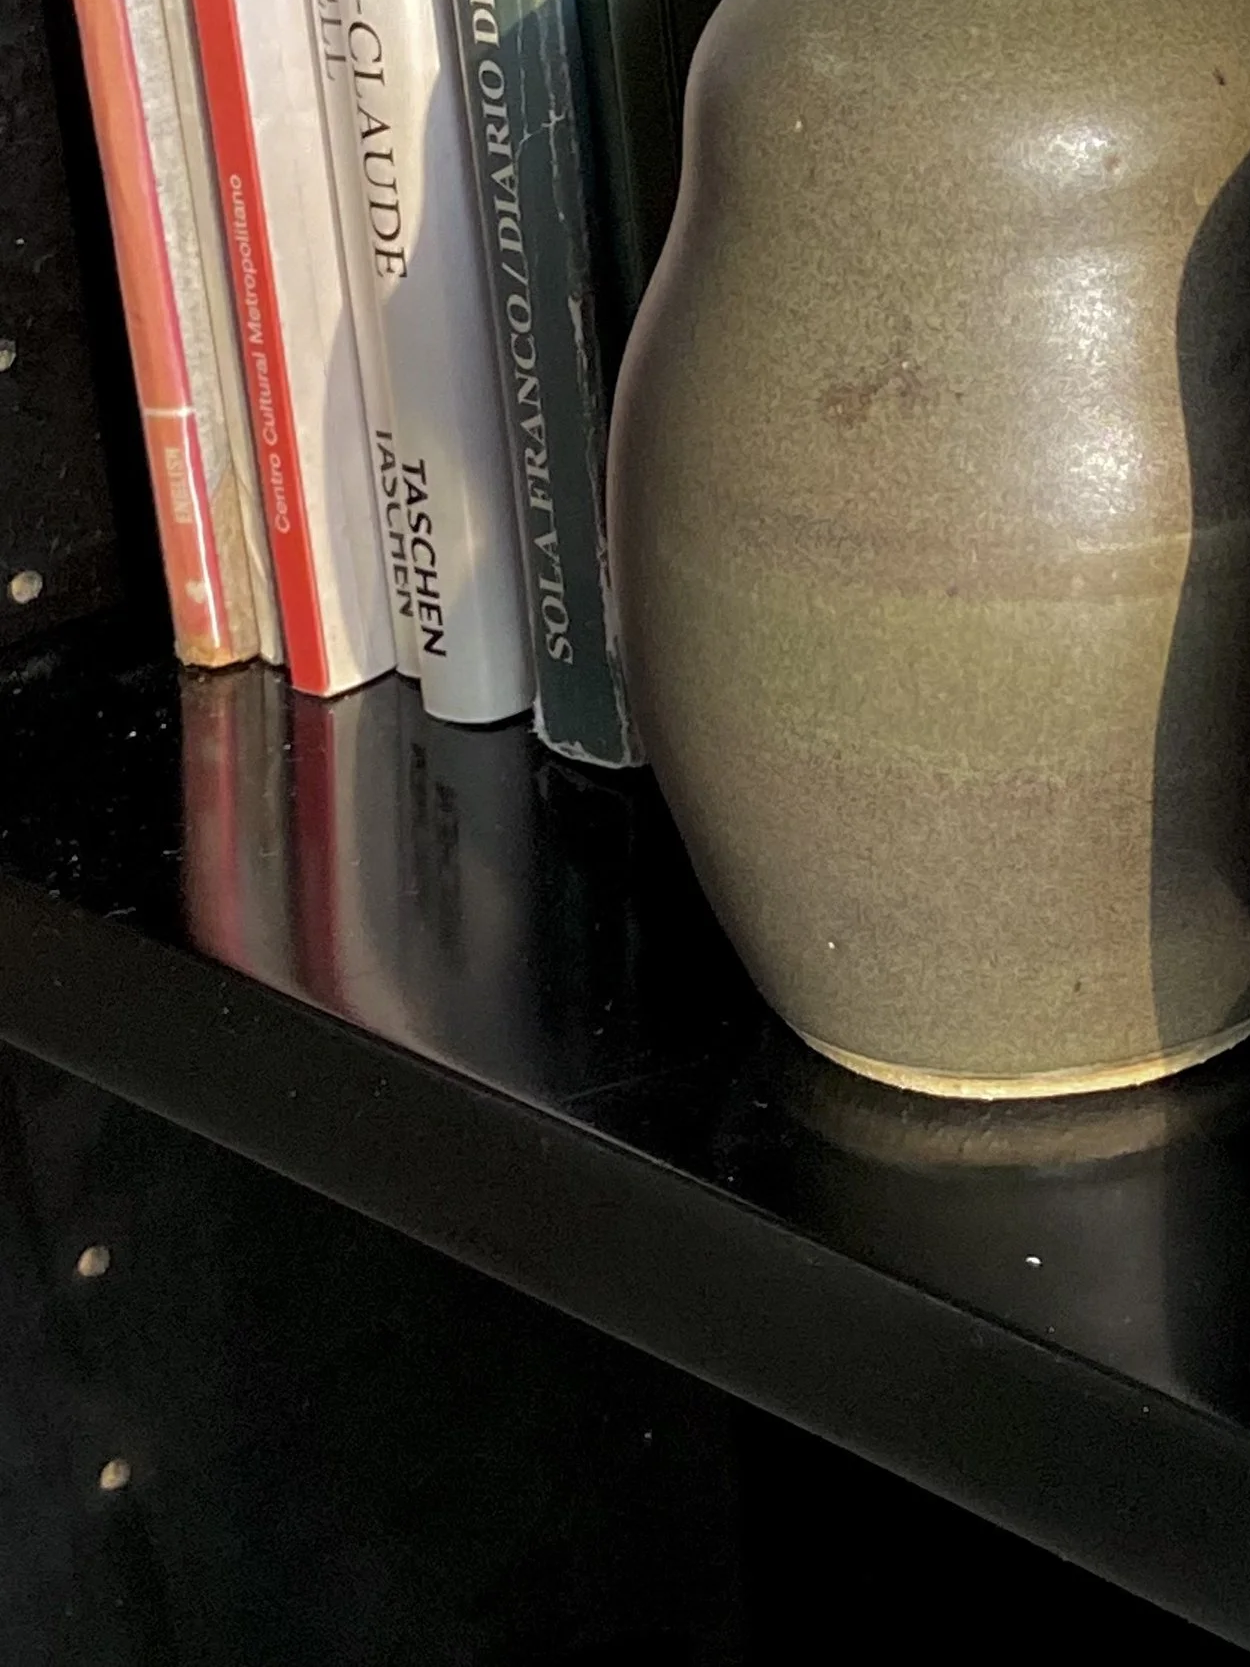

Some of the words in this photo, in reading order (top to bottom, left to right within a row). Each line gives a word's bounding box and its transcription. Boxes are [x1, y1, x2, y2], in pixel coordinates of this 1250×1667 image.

[230, 173, 264, 346] Metropolitano
[253, 350, 279, 447] Cultural
[270, 451, 291, 535] Centro
[401, 458, 447, 659] TASCHEN
[534, 530, 574, 666] SOLA
